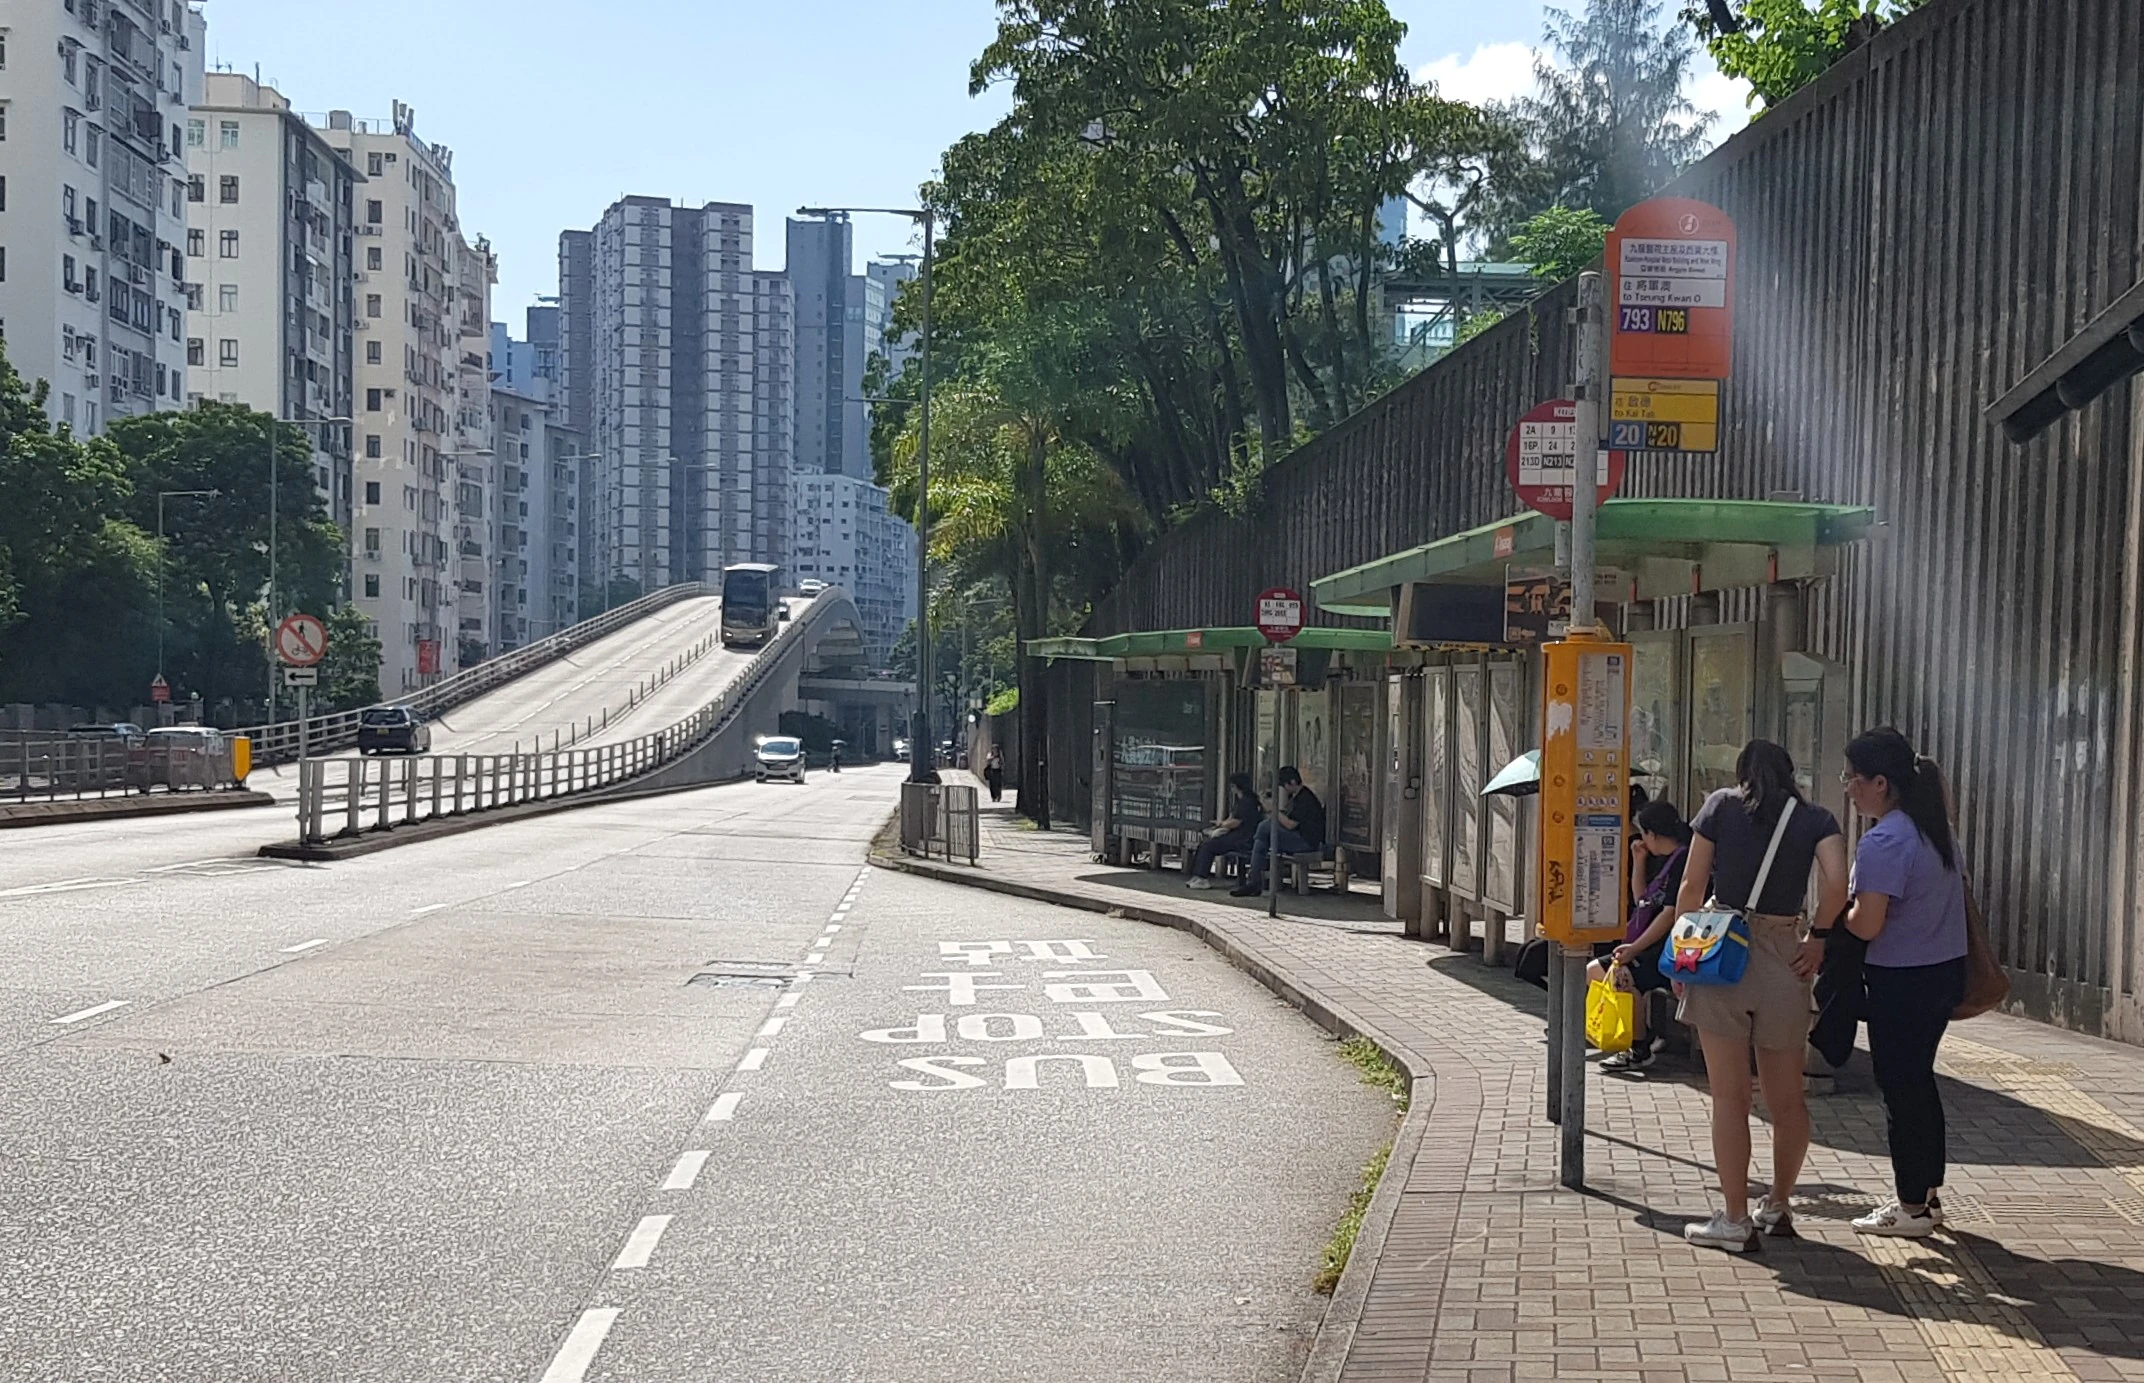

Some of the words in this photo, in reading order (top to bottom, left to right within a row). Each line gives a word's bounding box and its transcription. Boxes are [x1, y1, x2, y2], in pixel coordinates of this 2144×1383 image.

[1623, 293, 1632, 301] to
[1635, 293, 1665, 304] Tseung
[1668, 294, 1692, 303] Kwan
[1694, 295, 1701, 303] O
[1622, 308, 1650, 331] 793
[1657, 310, 1685, 332] N796
[1641, 410, 1655, 418] Tak
[1526, 425, 1536, 435] 2A
[1550, 425, 1556, 435] 9
[1615, 423, 1640, 446] 20
[1548, 441, 1558, 450] 24
[1521, 456, 1540, 466] 213D
[858, 1009, 1235, 1044] STOP
[888, 1051, 1246, 1091] BUS
